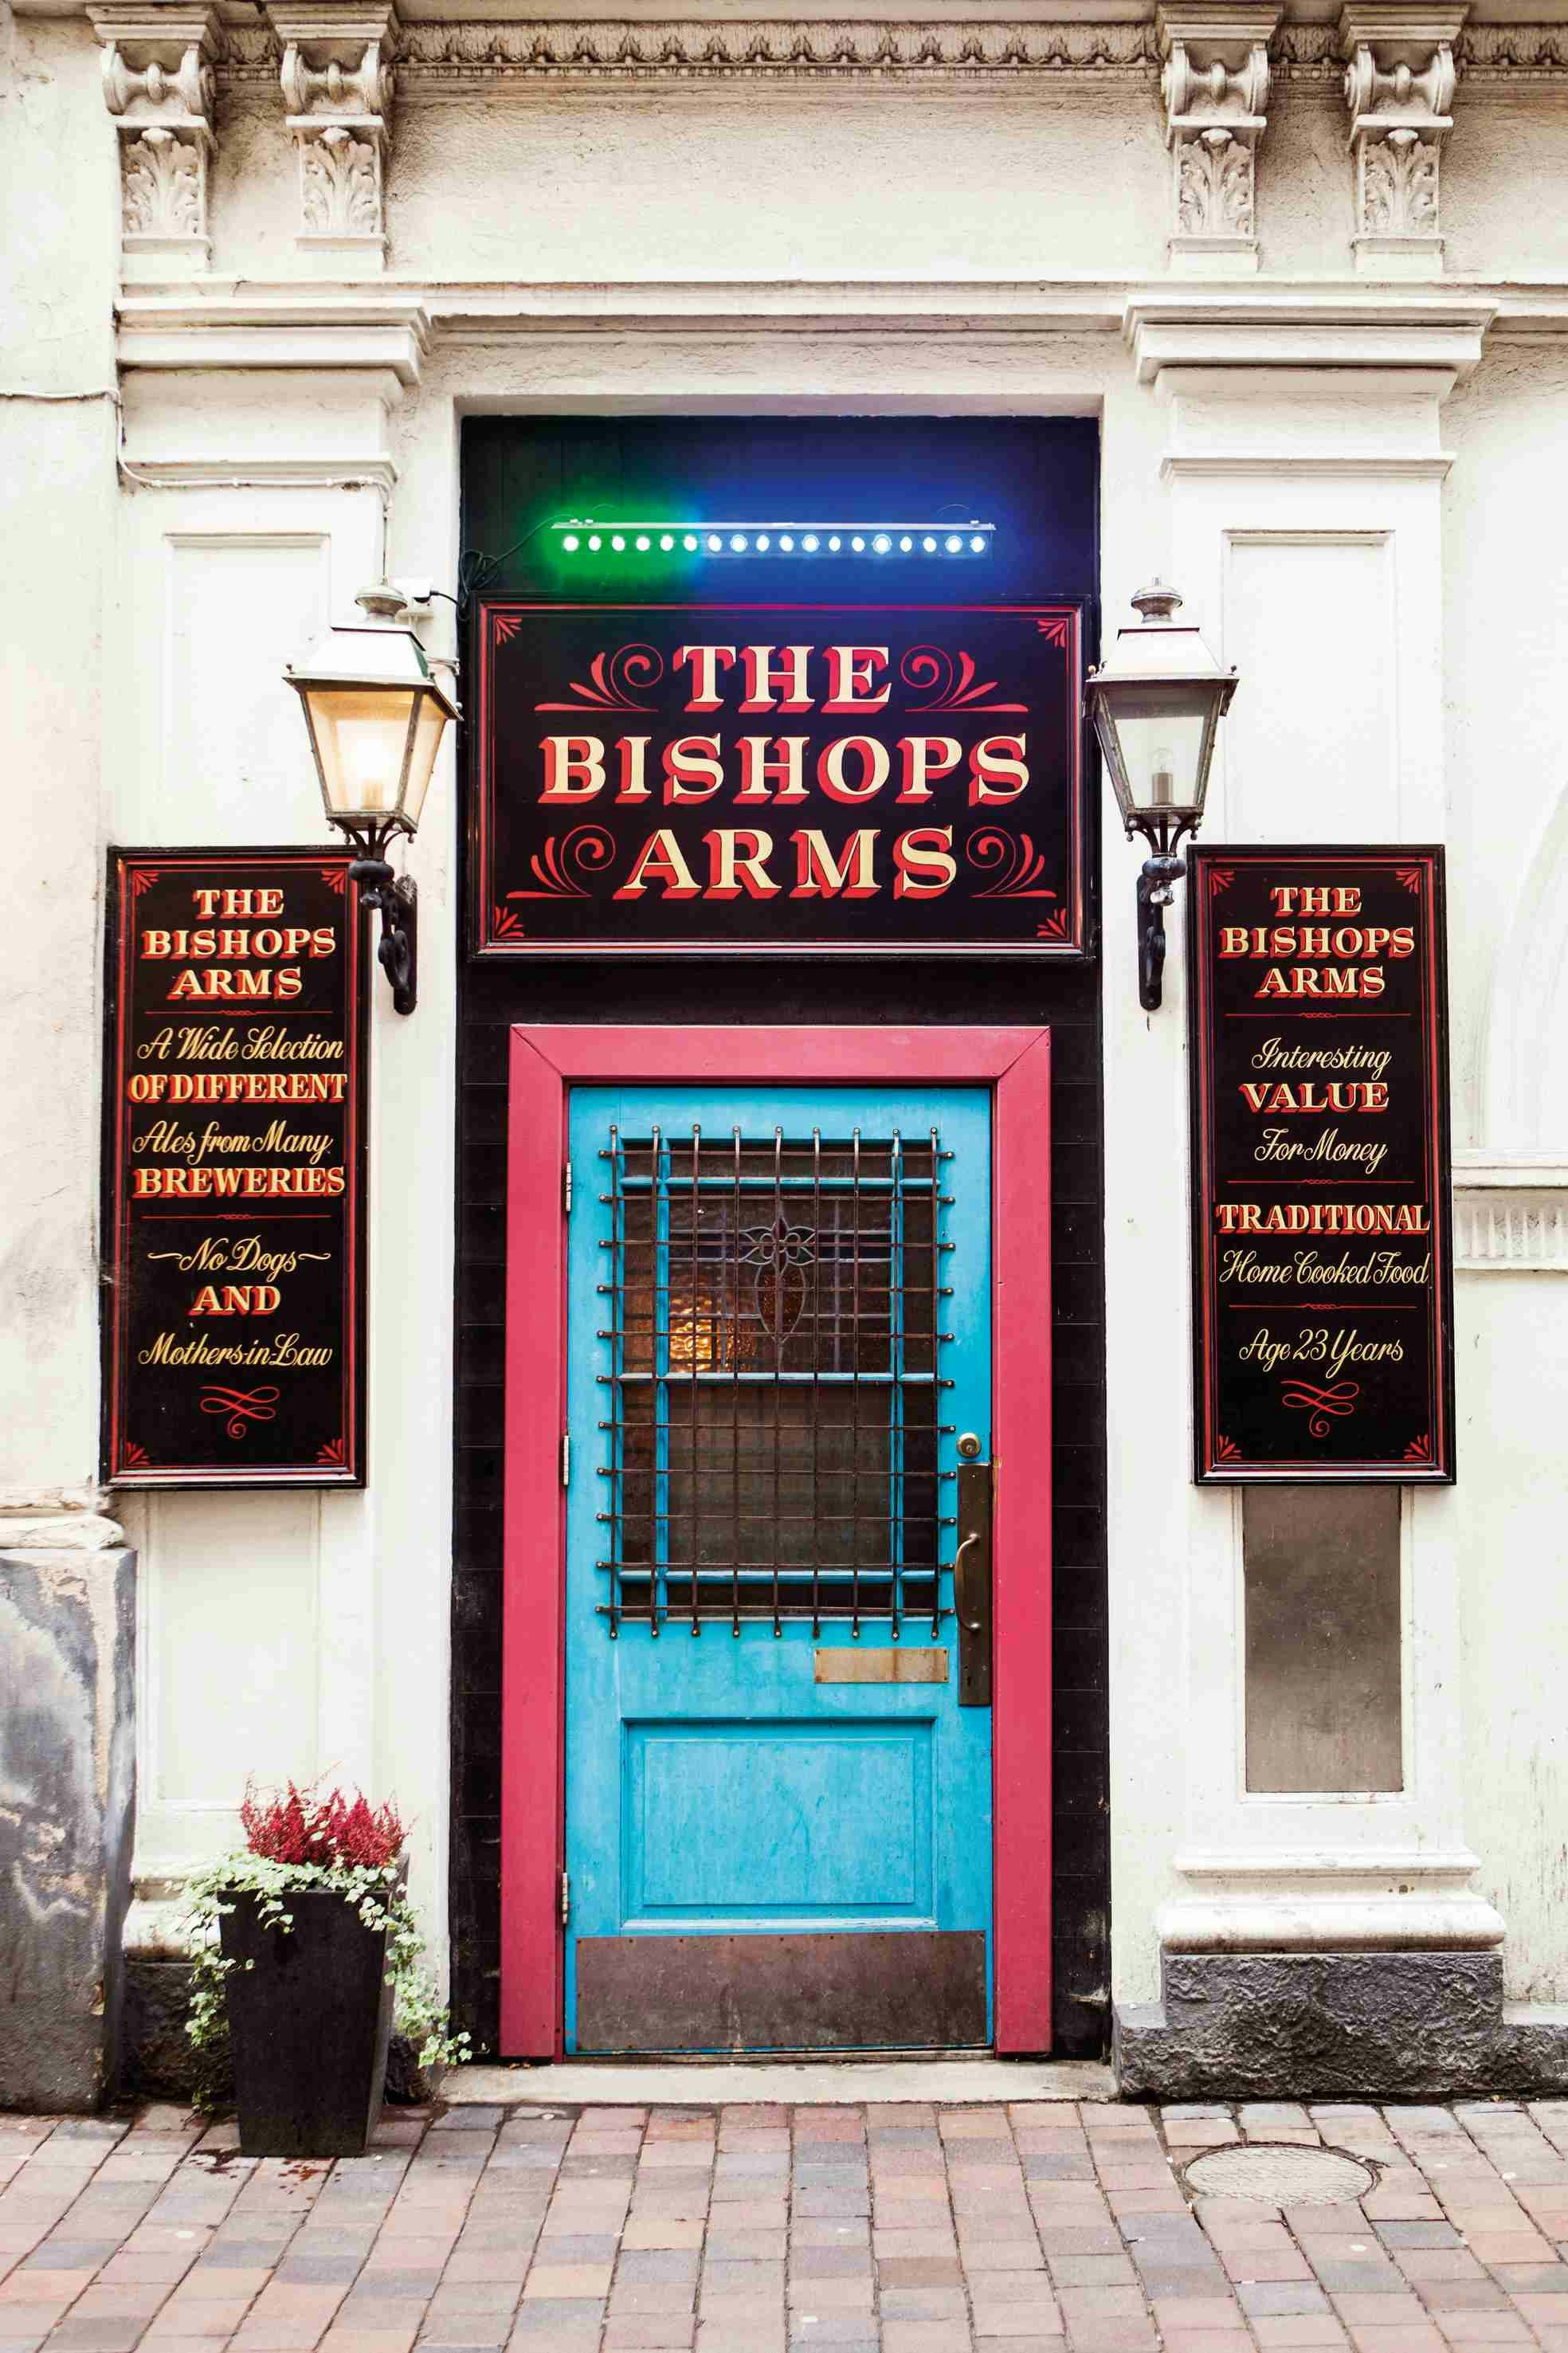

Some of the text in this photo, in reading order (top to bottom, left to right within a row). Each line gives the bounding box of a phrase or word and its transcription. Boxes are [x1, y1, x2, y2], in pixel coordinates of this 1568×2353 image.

[672, 645, 892, 713] THE
[538, 732, 1030, 805] BISHOPS
[612, 825, 958, 900] ARMS
[193, 888, 284, 920] THE
[1270, 887, 1362, 917] THE
[140, 927, 335, 960] BISHOPS
[1218, 927, 1415, 959] BISHOPS
[167, 967, 303, 1000] ARMS
[1254, 967, 1386, 999] ARMS
[137, 1026, 343, 1060] A Wide Selection
[1251, 1037, 1392, 1080] Interesting
[127, 1073, 347, 1104] OF DIFFERENT
[1239, 1082, 1389, 1113] VALUE
[132, 1120, 332, 1165] Ales from Many
[1254, 1127, 1387, 1174] For Money
[131, 1167, 345, 1199] BREWERIES
[1215, 1204, 1430, 1236] TRADITIONAL
[178, 1234, 297, 1283] No Dogs
[1219, 1250, 1430, 1285] Home Cooked Food
[186, 1285, 281, 1316] AND
[1239, 1329, 1404, 1379] Age 23 Years
